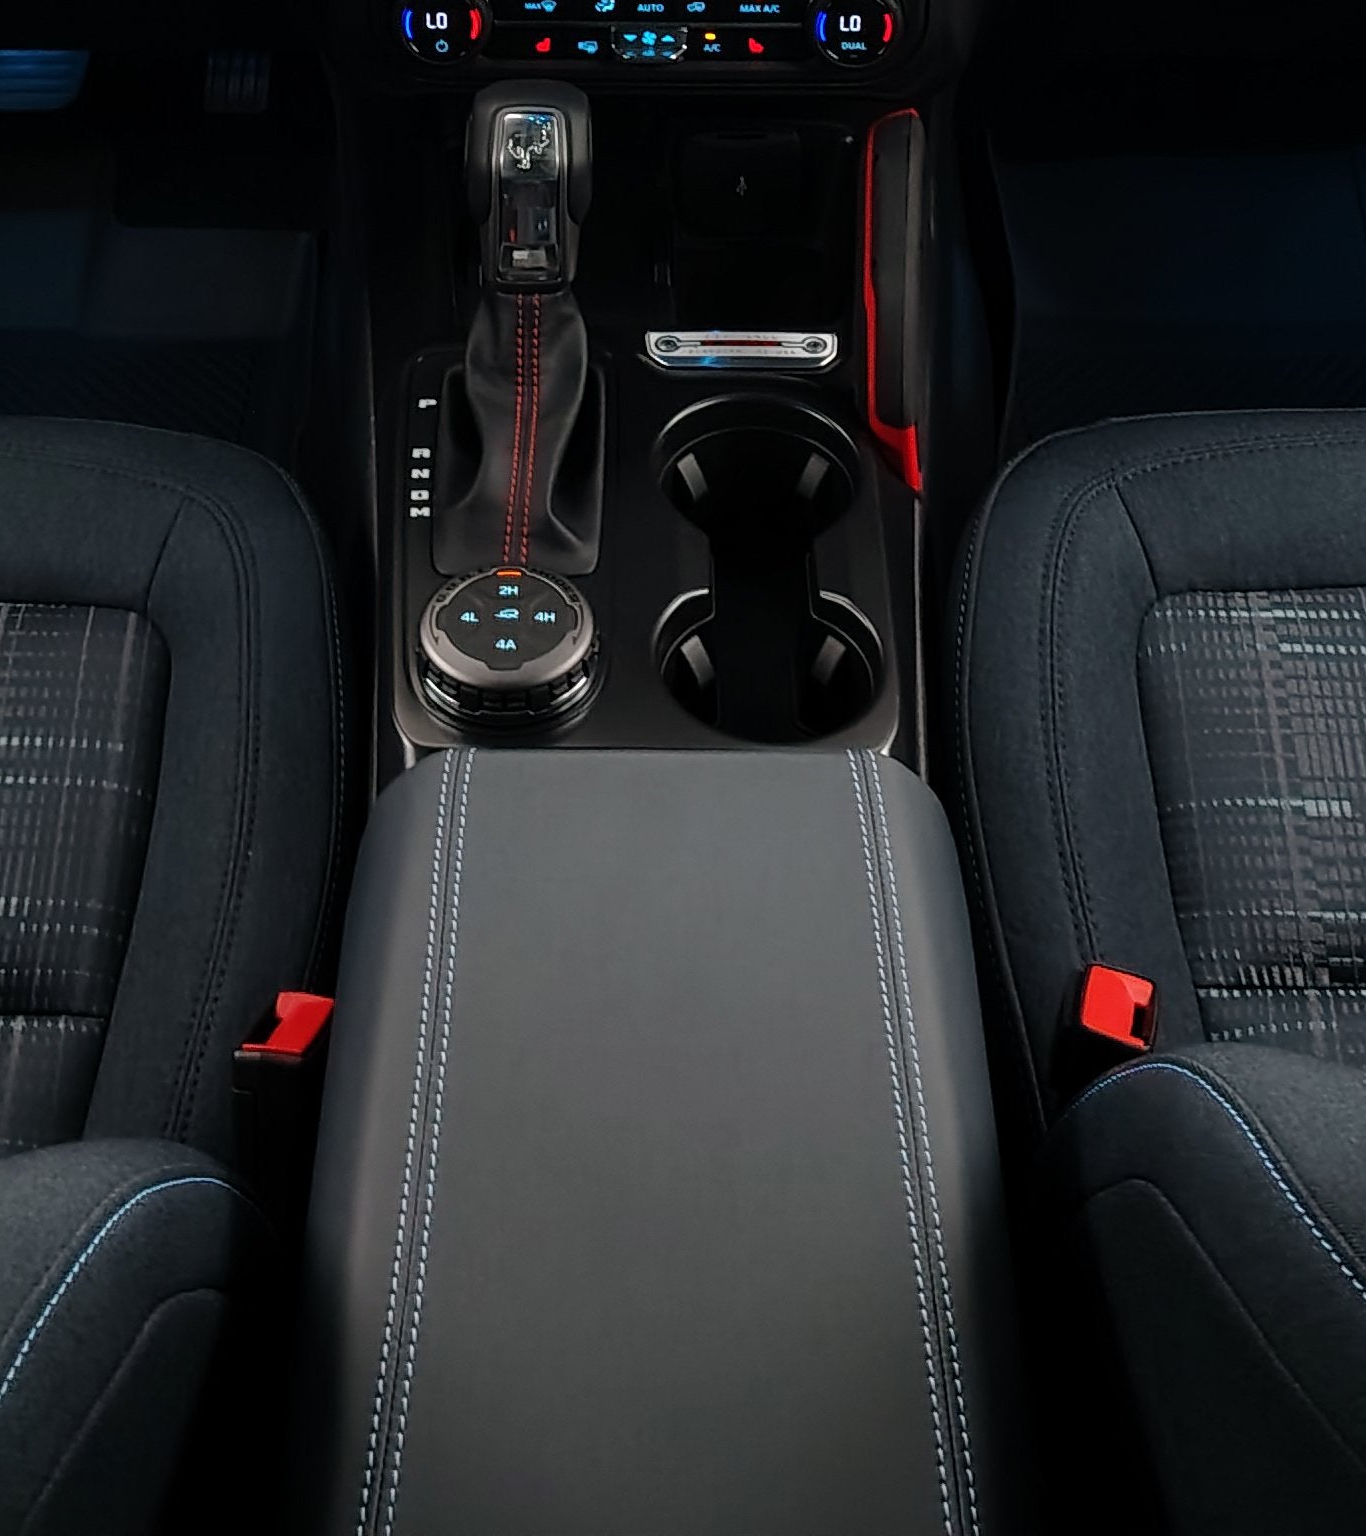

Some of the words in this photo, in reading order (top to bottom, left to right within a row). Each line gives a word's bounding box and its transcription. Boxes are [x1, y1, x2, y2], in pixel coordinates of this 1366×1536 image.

[637, 3, 665, 13] AUTO
[739, 4, 762, 13] MAX
[762, 4, 781, 14] A/C
[425, 11, 448, 30] LO
[839, 14, 862, 32] LO
[703, 43, 722, 53] A/C
[841, 41, 867, 51] DUAL
[418, 398, 437, 409] P
[412, 447, 431, 459] R
[411, 468, 430, 479] N
[410, 489, 429, 501] D
[409, 506, 431, 517] M
[498, 585, 520, 597] 2H
[459, 611, 480, 623] 4L
[533, 611, 556, 623] 4H
[494, 638, 517, 651] 4A
